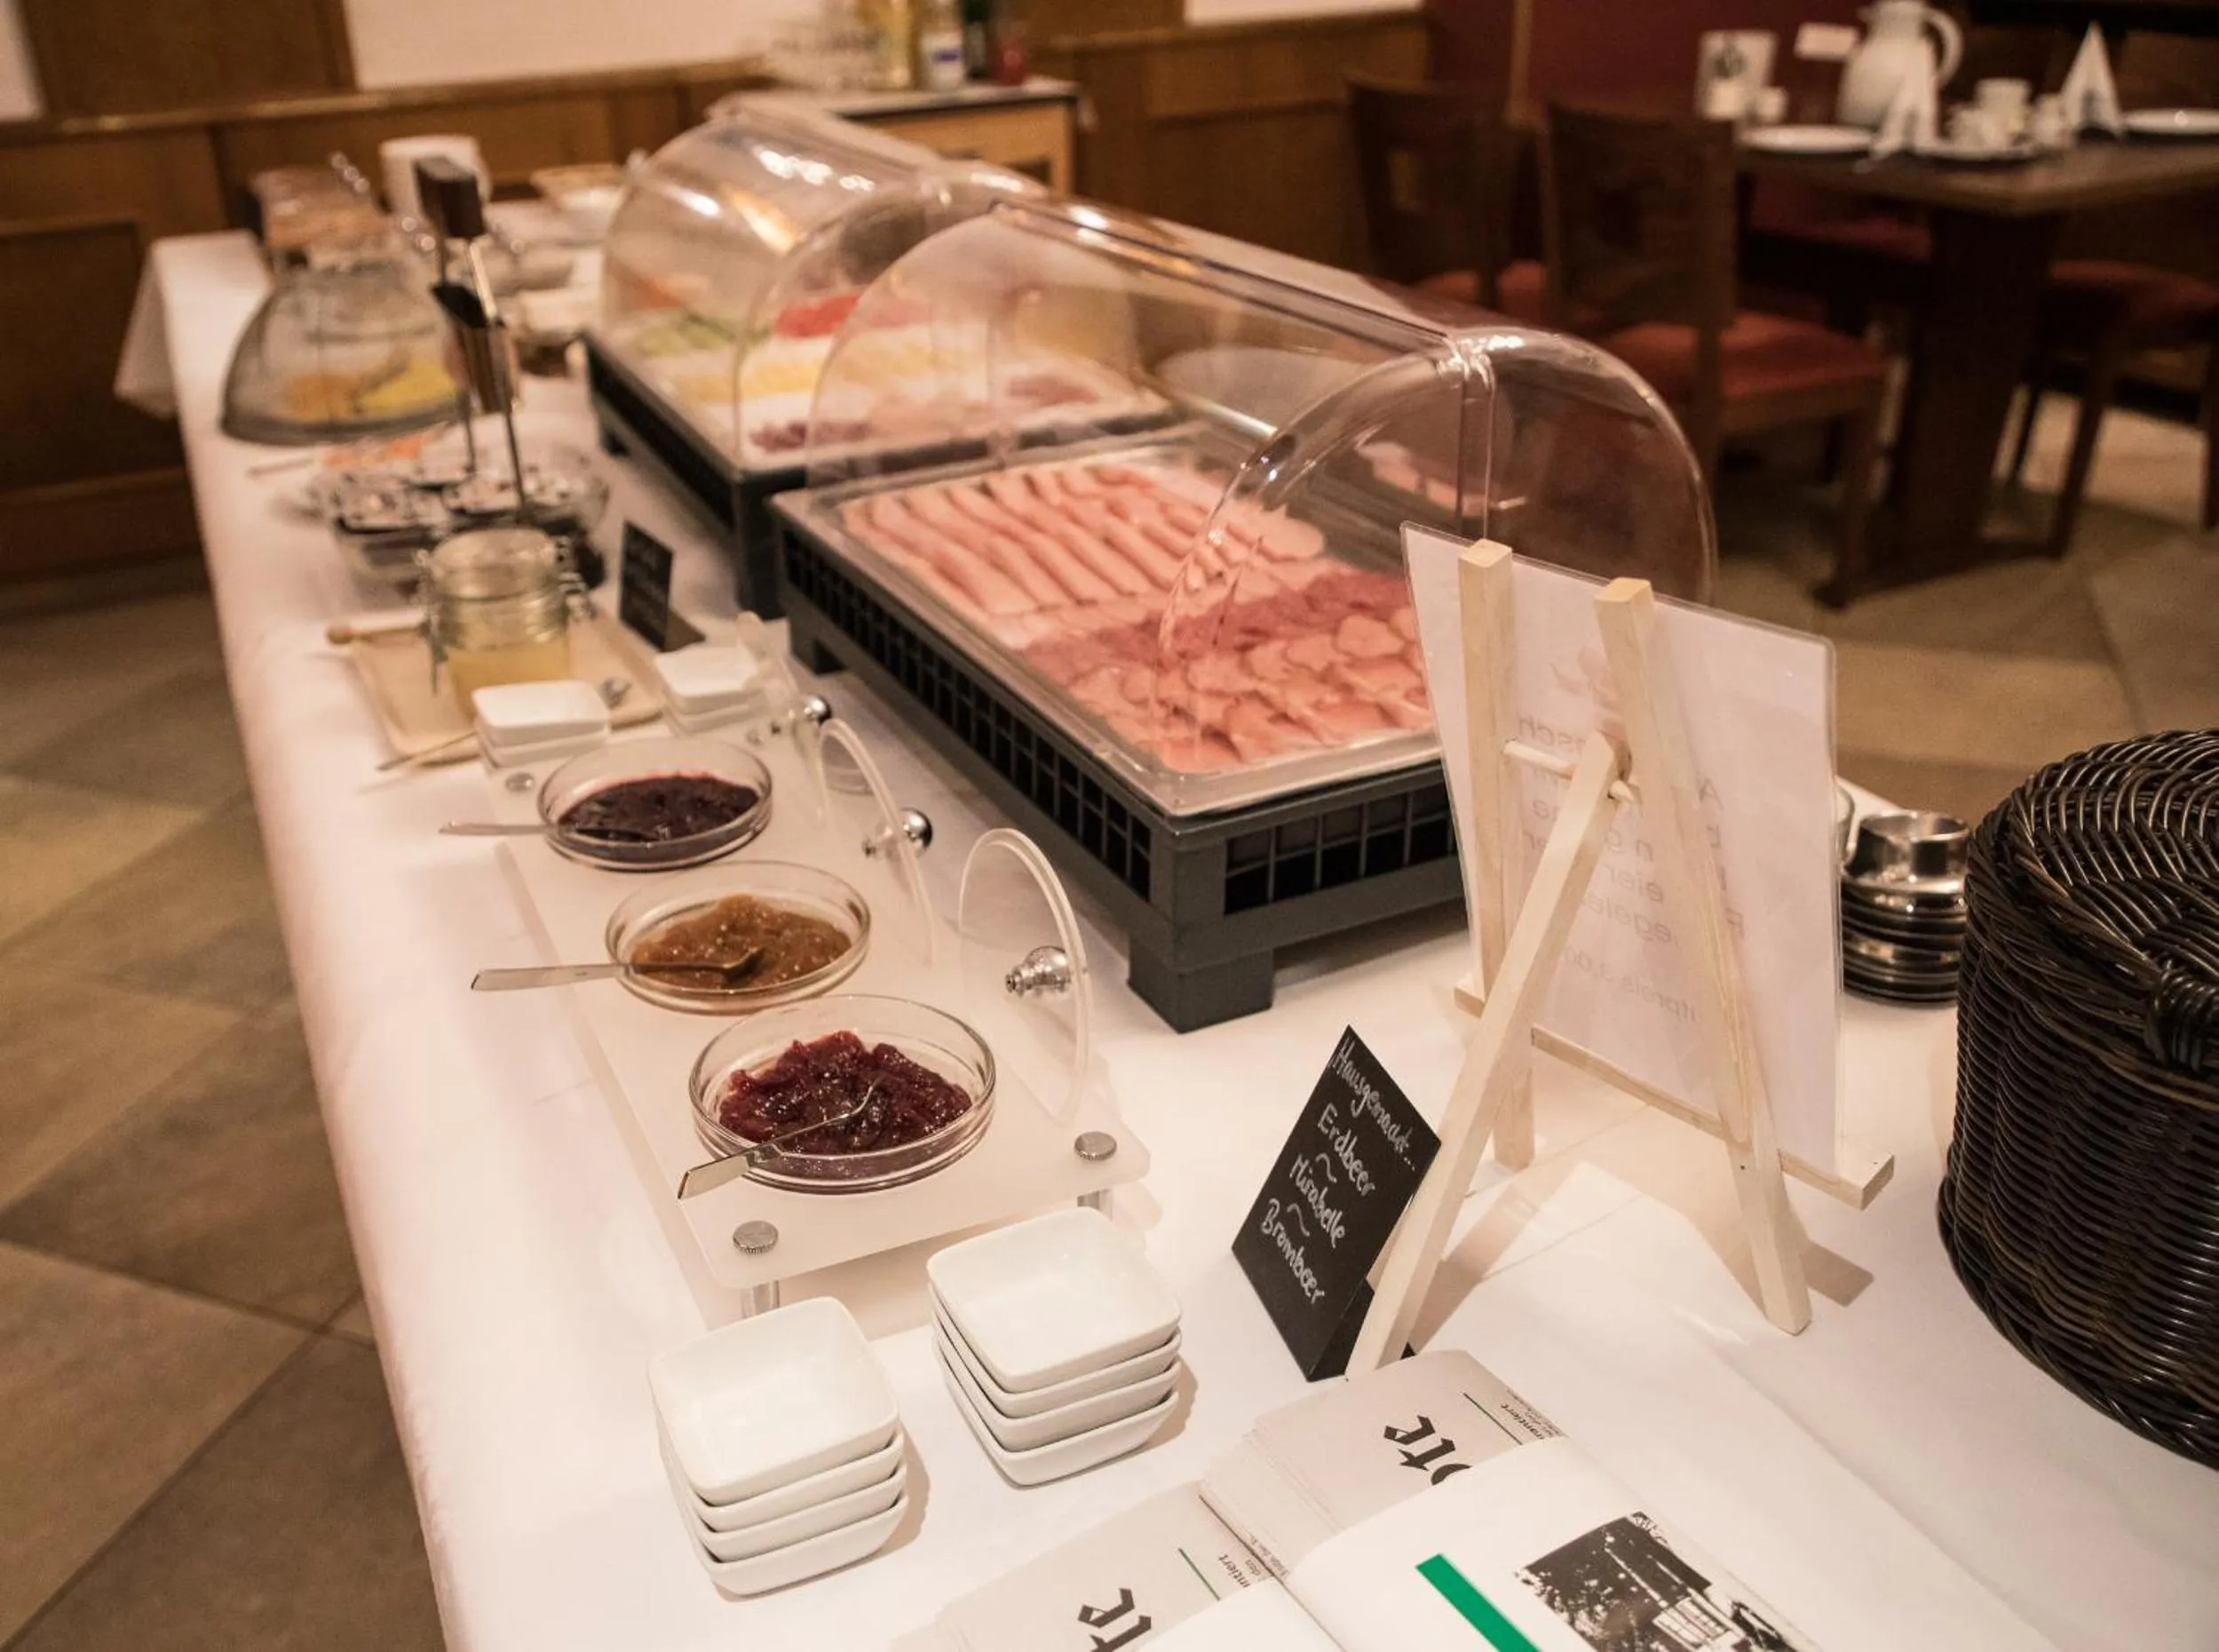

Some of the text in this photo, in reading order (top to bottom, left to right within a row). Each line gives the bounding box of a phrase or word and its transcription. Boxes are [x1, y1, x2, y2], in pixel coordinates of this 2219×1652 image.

[1317, 1103, 1375, 1197] Erdbeer
[1288, 1154, 1346, 1248] Mirabelle
[1260, 1198, 1325, 1304] Brombeer
